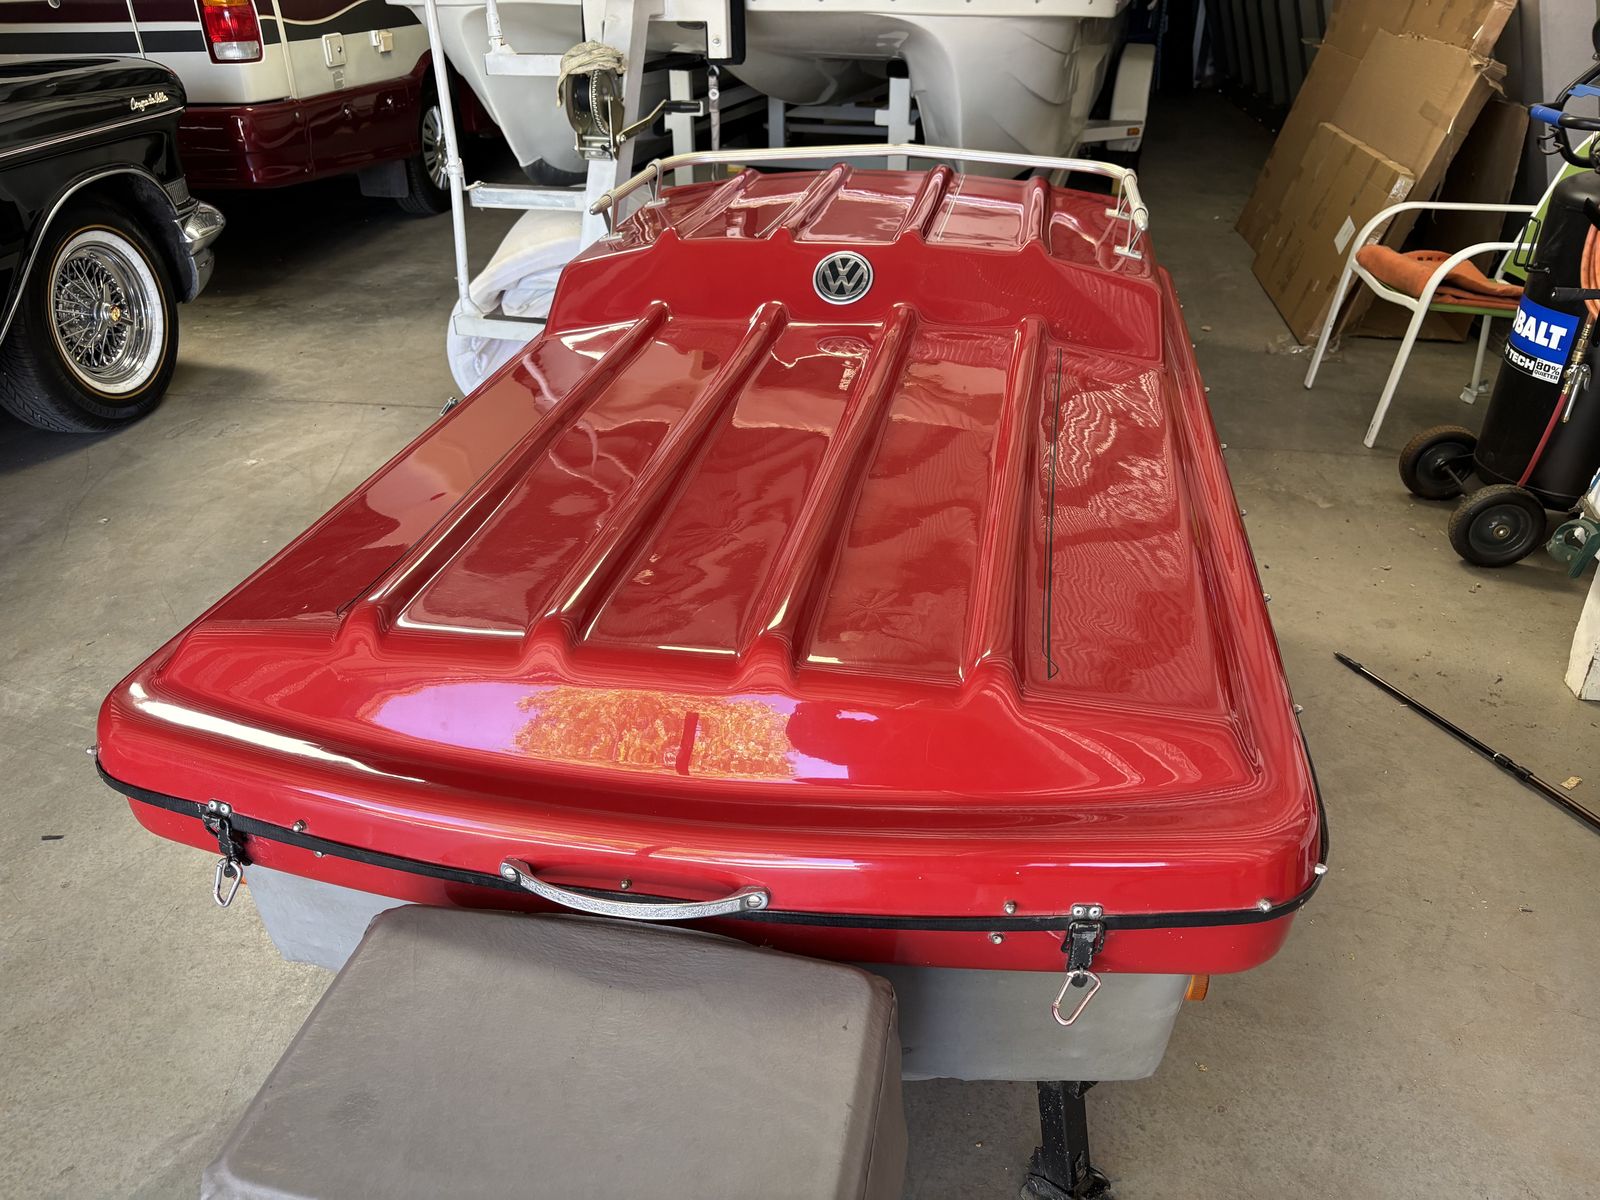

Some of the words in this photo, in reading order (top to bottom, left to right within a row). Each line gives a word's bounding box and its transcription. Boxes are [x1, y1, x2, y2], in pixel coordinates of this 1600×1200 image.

[819, 254, 868, 299] VW
[1513, 306, 1568, 350] BALT
[1508, 348, 1536, 371] TECH
[1535, 360, 1561, 376] 80%
[1533, 369, 1559, 381] QUIETER
